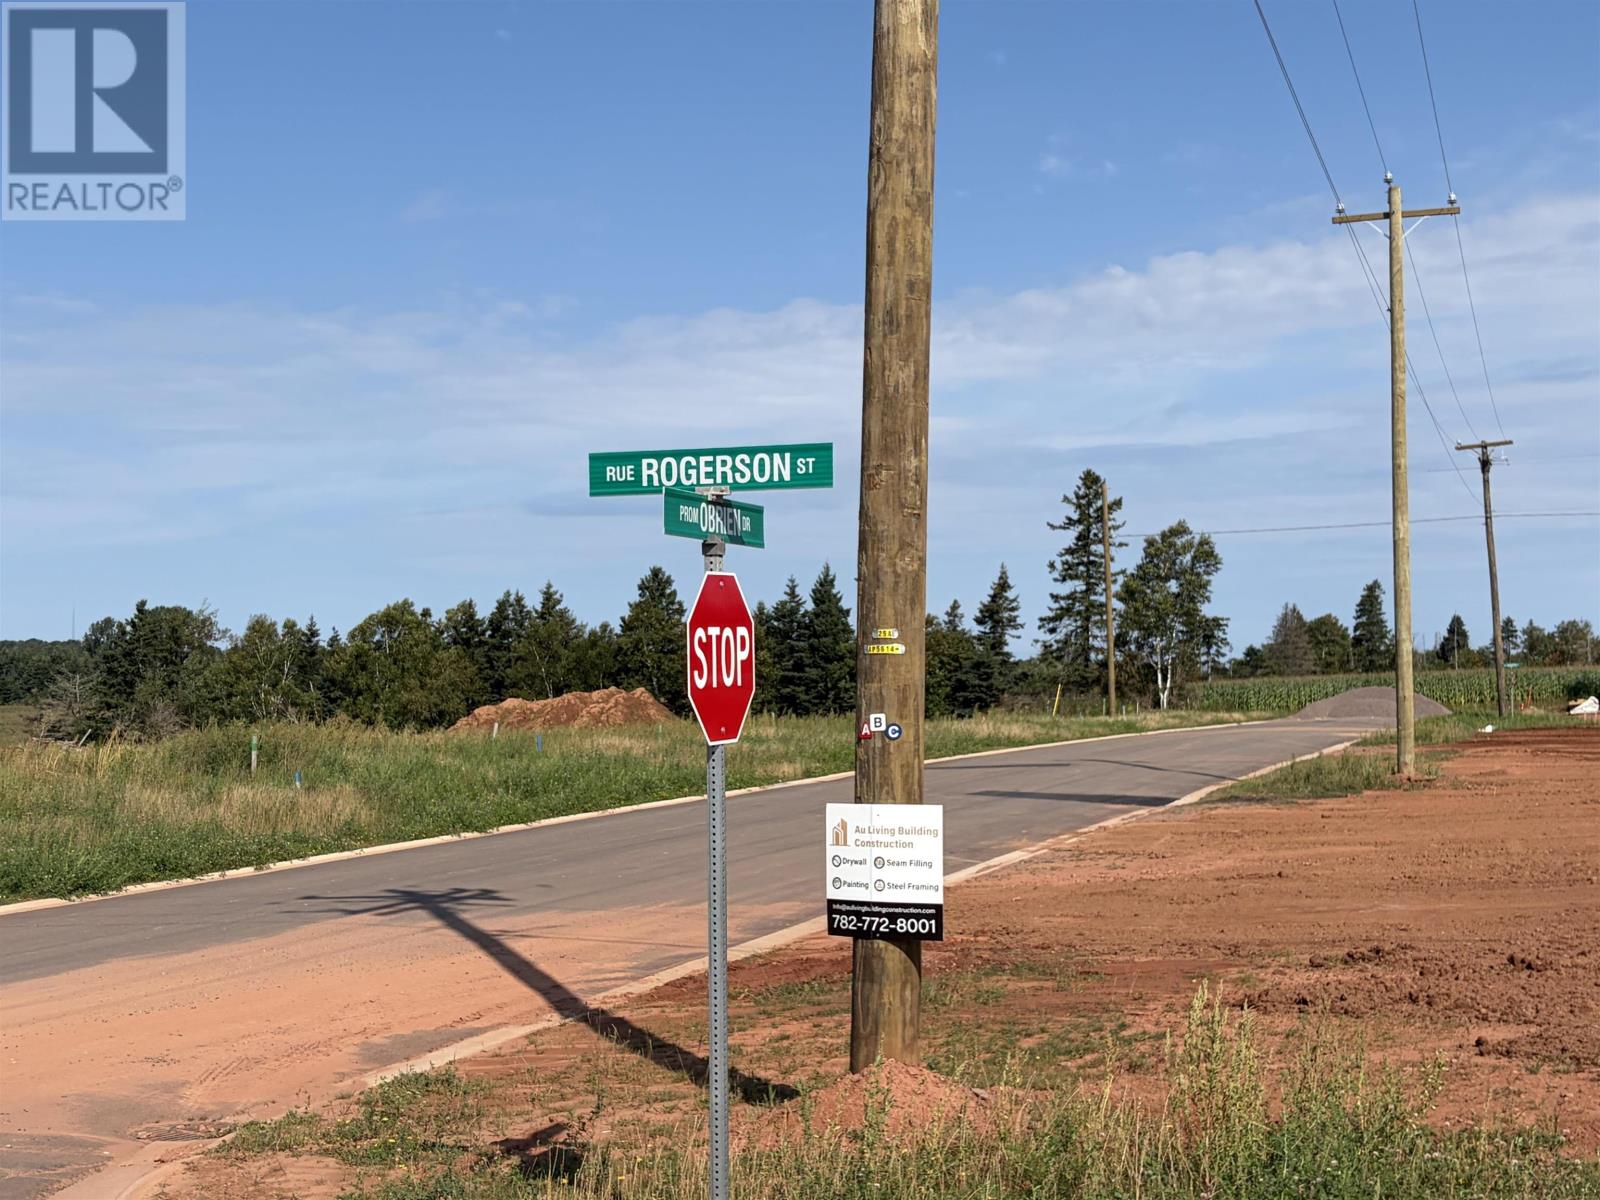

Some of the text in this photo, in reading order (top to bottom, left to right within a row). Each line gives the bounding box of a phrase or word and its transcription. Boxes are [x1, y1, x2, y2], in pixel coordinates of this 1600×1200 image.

[606, 452, 816, 487] RUE ROGERSON ST
[680, 502, 751, 536] PROM OBRIEN DR
[693, 626, 750, 690] STOP
[873, 717, 883, 728] B
[861, 723, 871, 736] A
[888, 725, 900, 738] C
[854, 825, 939, 838] Au Living Building
[854, 838, 914, 849] Construction
[842, 857, 867, 867] Drywall
[886, 859, 933, 869] Seam Filling
[842, 880, 869, 890] Painting
[886, 882, 939, 892] Steel Framing
[831, 914, 937, 934] 782-772-8001
